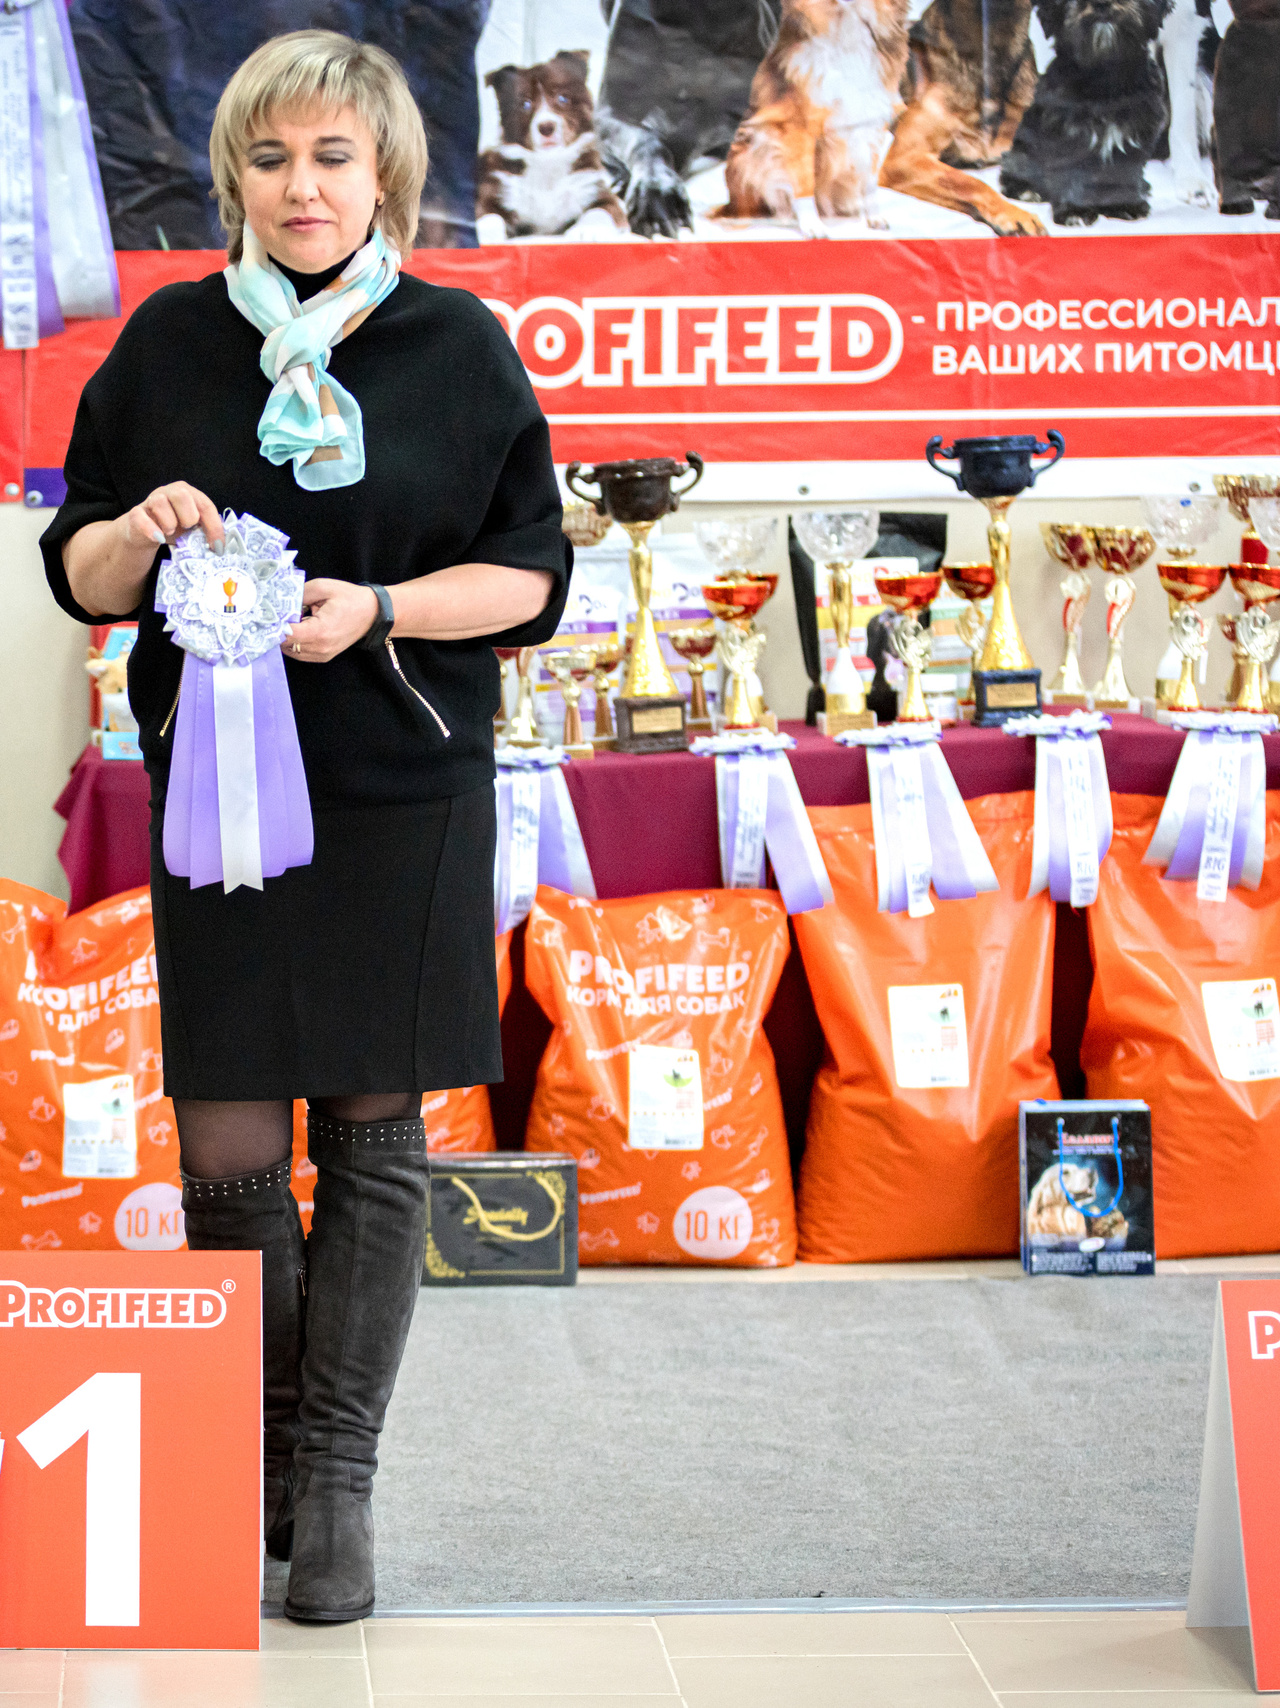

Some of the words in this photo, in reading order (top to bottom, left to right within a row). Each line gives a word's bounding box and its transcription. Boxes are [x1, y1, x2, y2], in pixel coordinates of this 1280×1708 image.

[936, 296, 1280, 332] ПРОФЕССИОНАЛ
[490, 293, 904, 389] OFIFEED
[932, 343, 1085, 376] ВАШИХ
[1094, 340, 1280, 377] ПИТОМЦ
[570, 950, 750, 994] PROFIFEED
[58, 1006, 100, 1032] ДЛЯ
[104, 987, 160, 1014] СОБА
[566, 985, 622, 1009] КОРМ
[624, 995, 671, 1017] ДЛЯ
[676, 990, 746, 1017] СОБАК
[125, 1206, 149, 1238] 10
[683, 1210, 709, 1242] 10
[15, 1371, 142, 1627] 1
